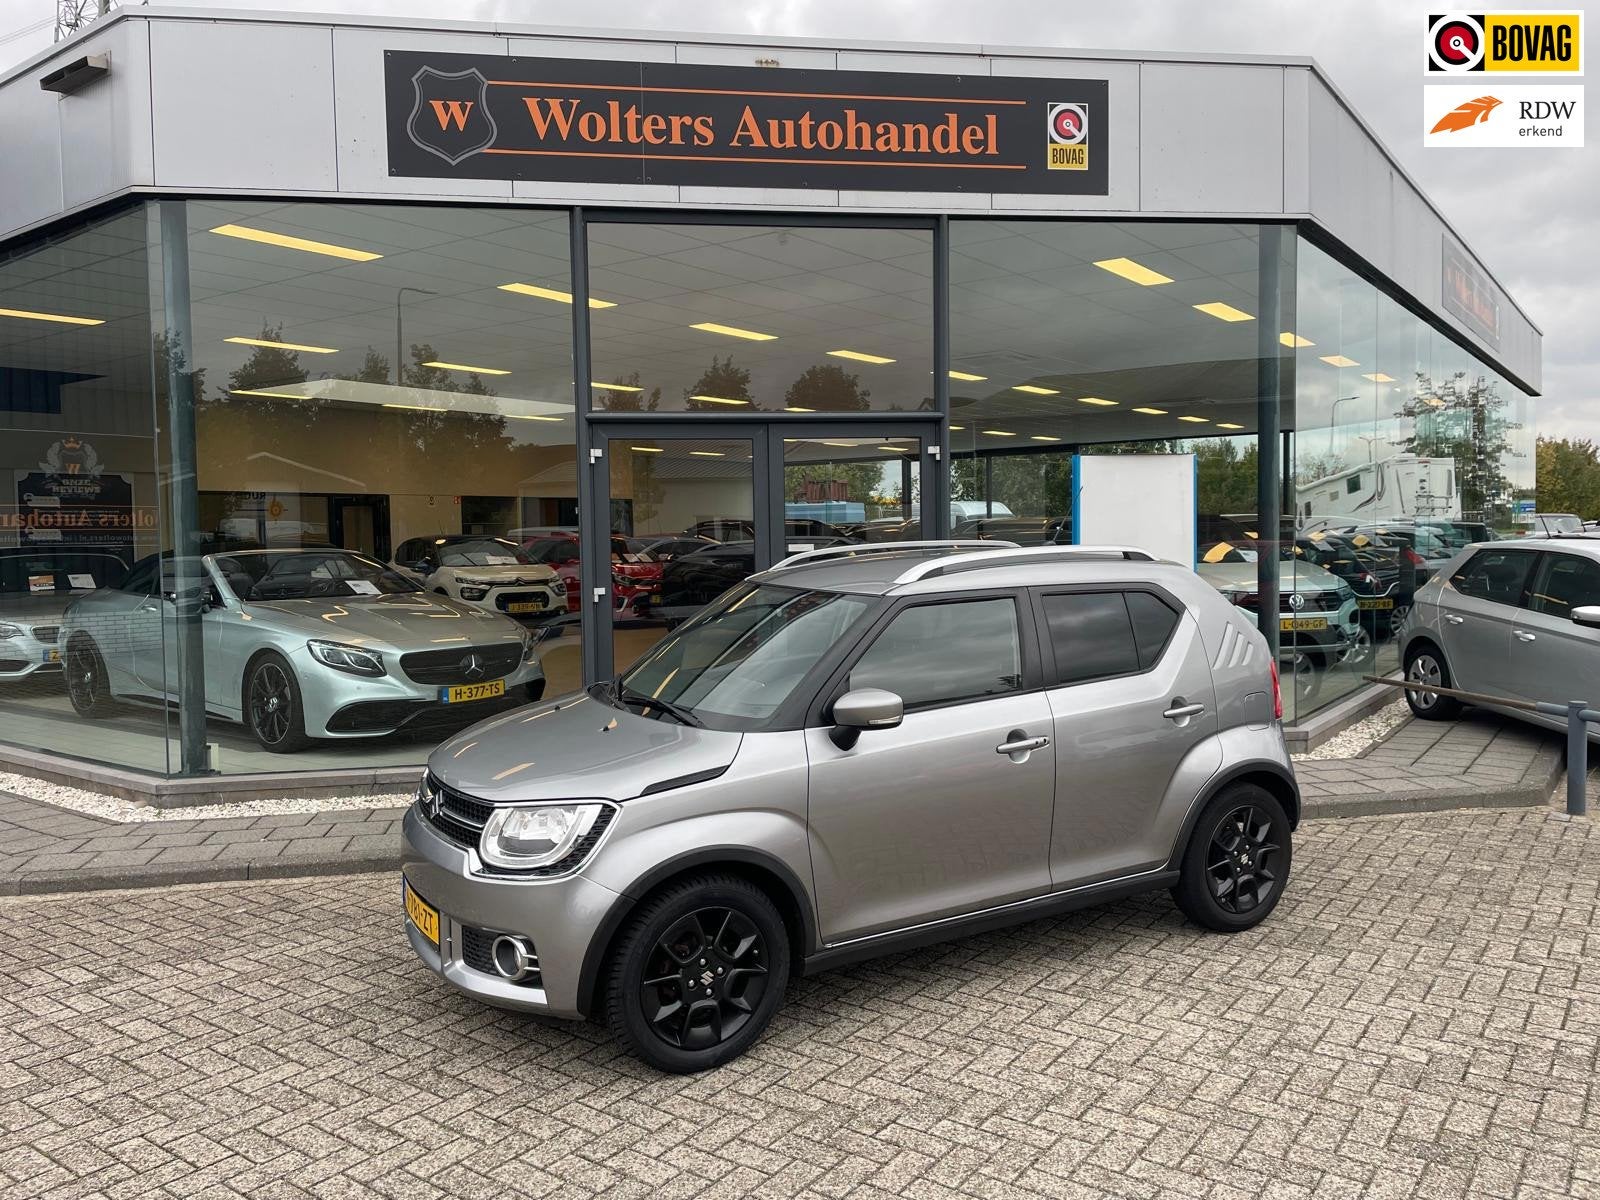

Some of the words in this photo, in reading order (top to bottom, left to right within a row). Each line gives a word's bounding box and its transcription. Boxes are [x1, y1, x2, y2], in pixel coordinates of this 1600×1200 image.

[430, 99, 474, 131] W
[522, 96, 714, 147] Wolters
[730, 105, 999, 156] Autohandel
[1052, 148, 1084, 165] BOVAG
[454, 683, 500, 700] H-377-TS
